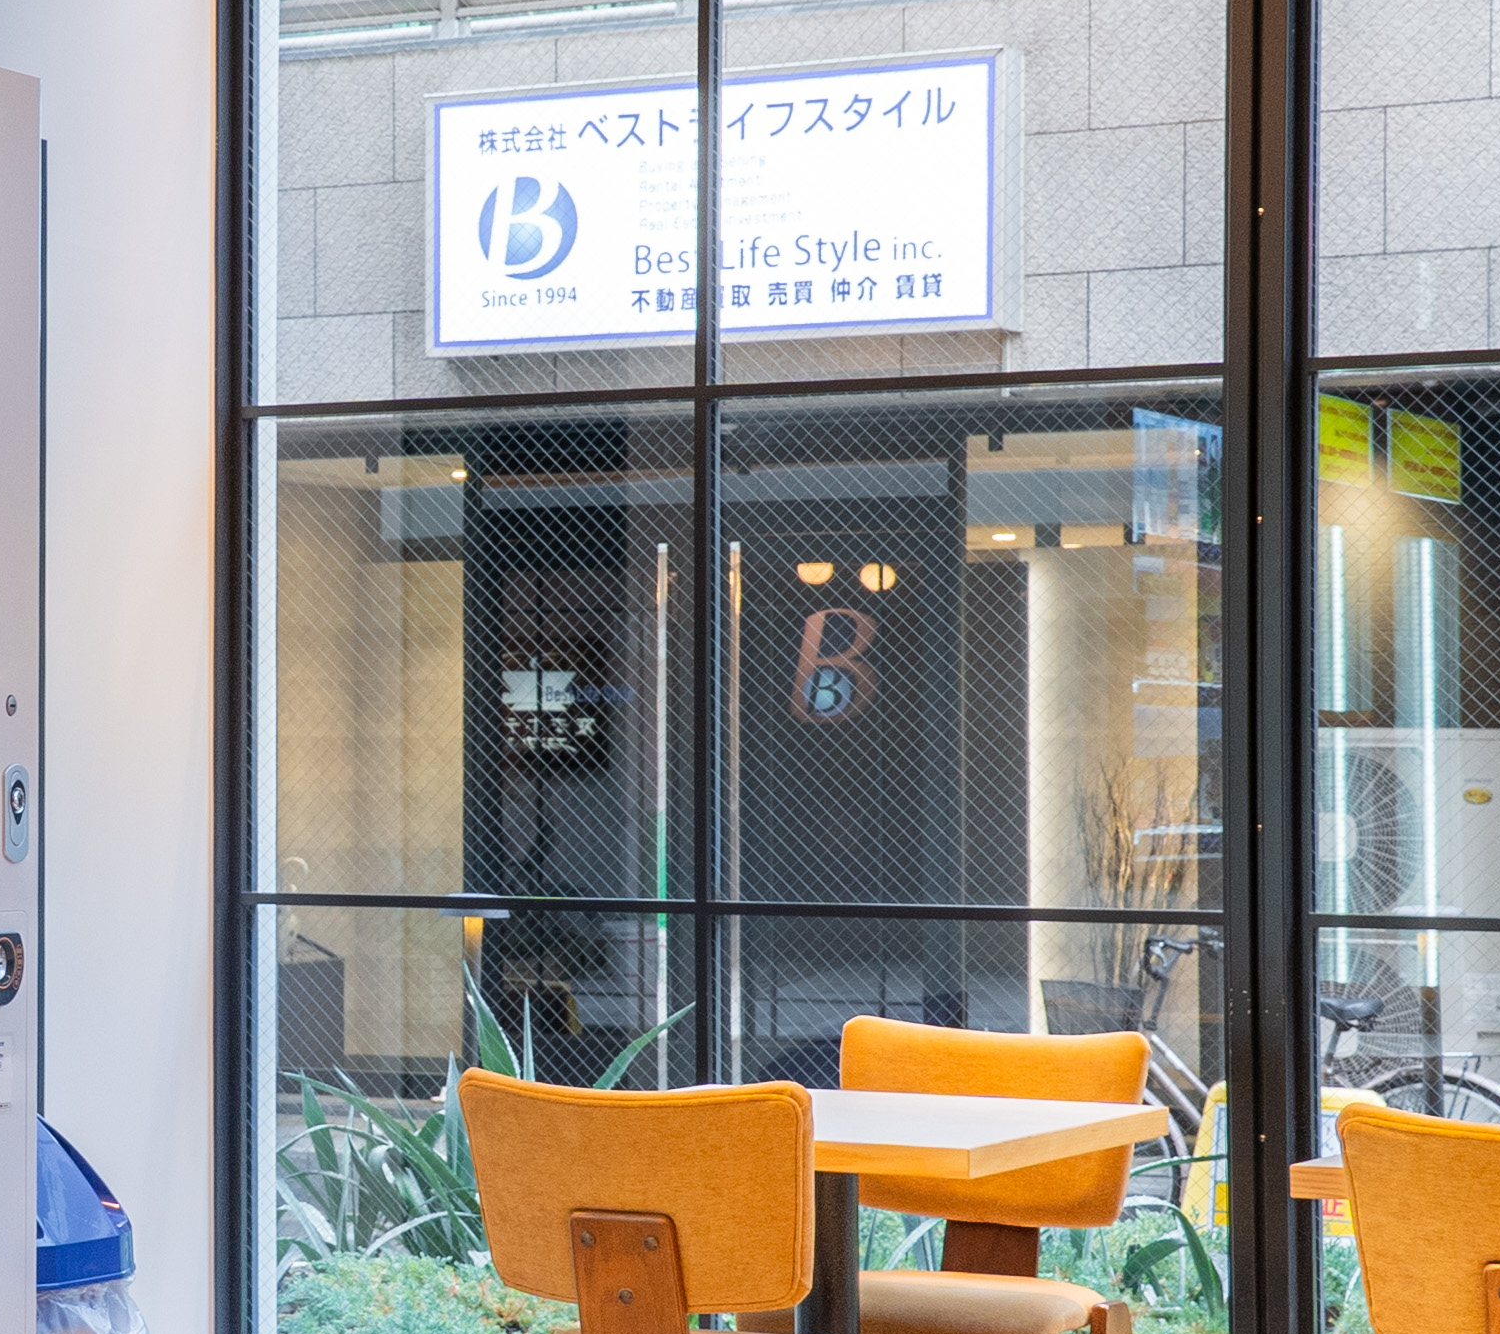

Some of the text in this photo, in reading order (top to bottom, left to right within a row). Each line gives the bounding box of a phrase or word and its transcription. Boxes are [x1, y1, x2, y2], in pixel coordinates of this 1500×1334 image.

[477, 87, 957, 156] 株式会社 ベストイフスタイル
[634, 244, 698, 275] Bes
[795, 230, 882, 273] Style
[892, 236, 944, 262] inc.
[481, 286, 578, 308] Since 1994
[767, 280, 813, 306] 売買
[829, 276, 879, 303] 仲介
